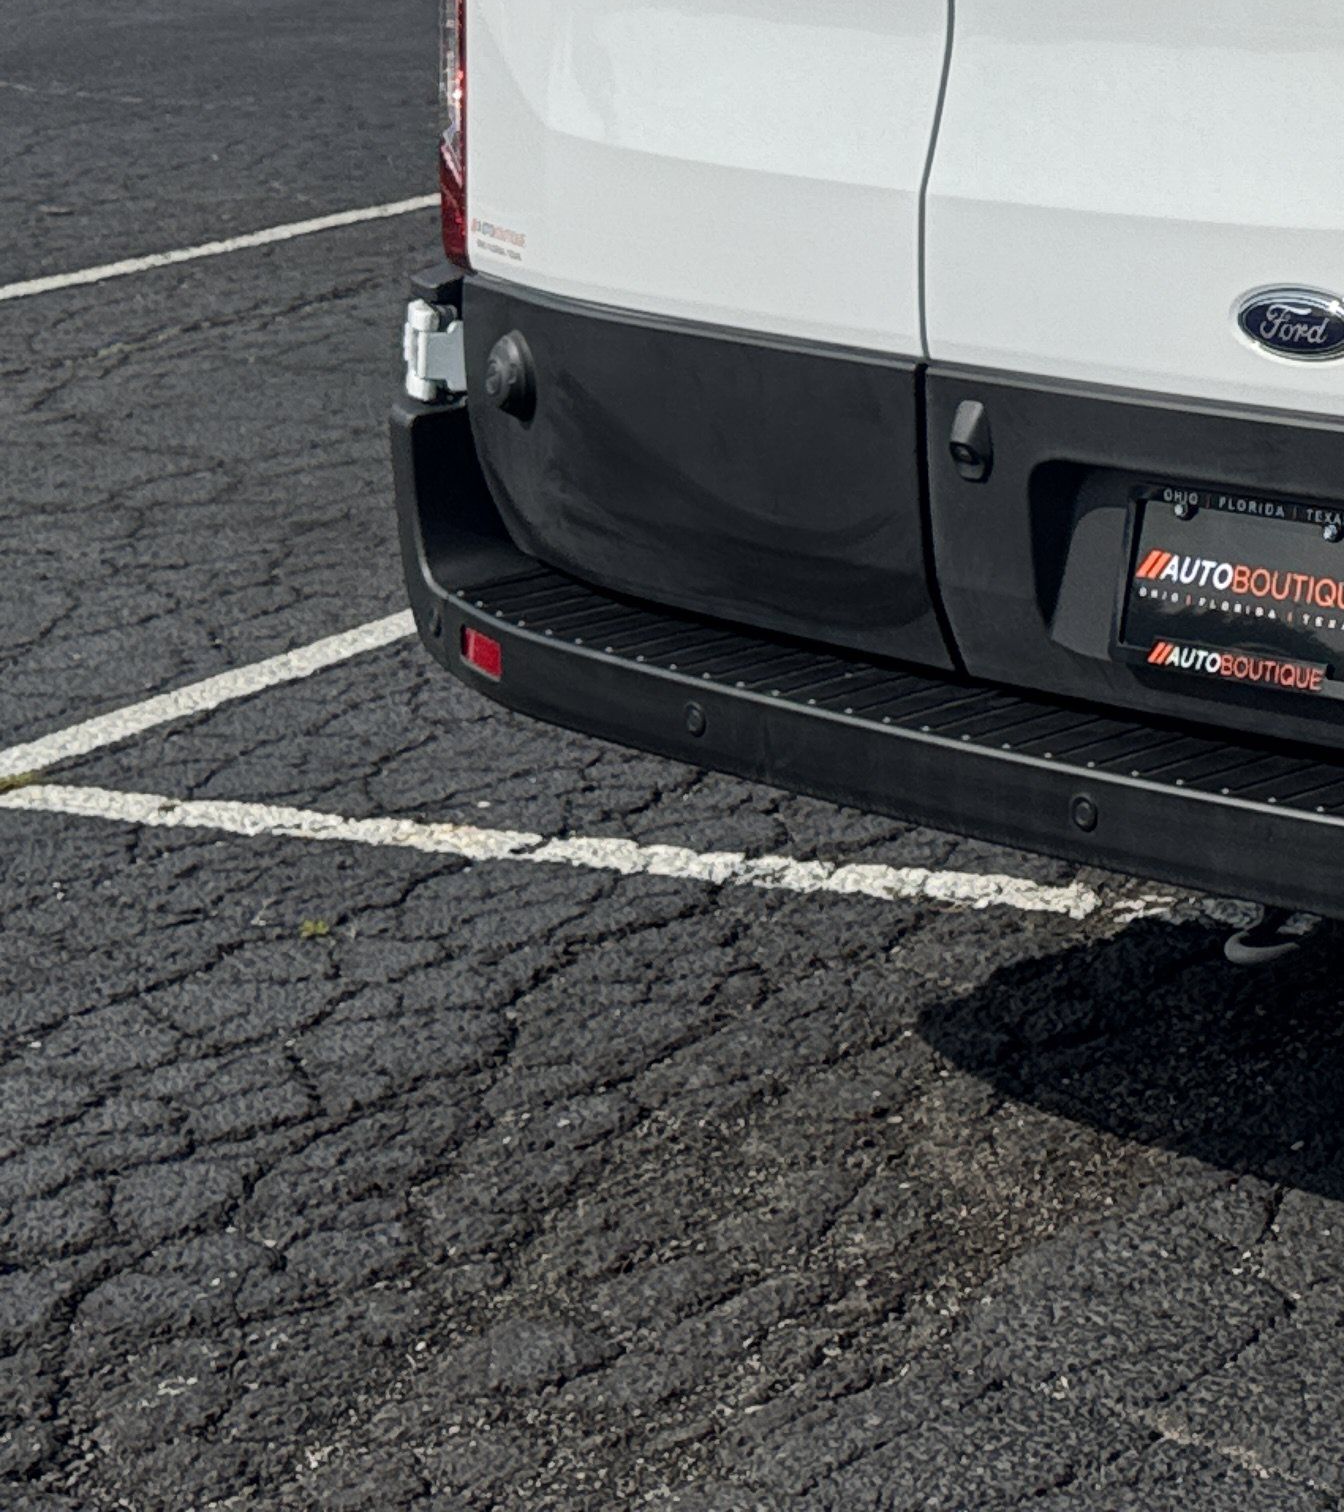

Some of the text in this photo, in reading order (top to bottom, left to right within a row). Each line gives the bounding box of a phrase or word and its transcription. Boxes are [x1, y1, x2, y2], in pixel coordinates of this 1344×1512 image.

[1260, 304, 1330, 344] Ford
[1163, 488, 1199, 506] OHIO
[1218, 496, 1286, 519] FLORIDA
[1139, 586, 1179, 603] OHIO
[1168, 645, 1325, 691] AUTOBOUTIQUE
